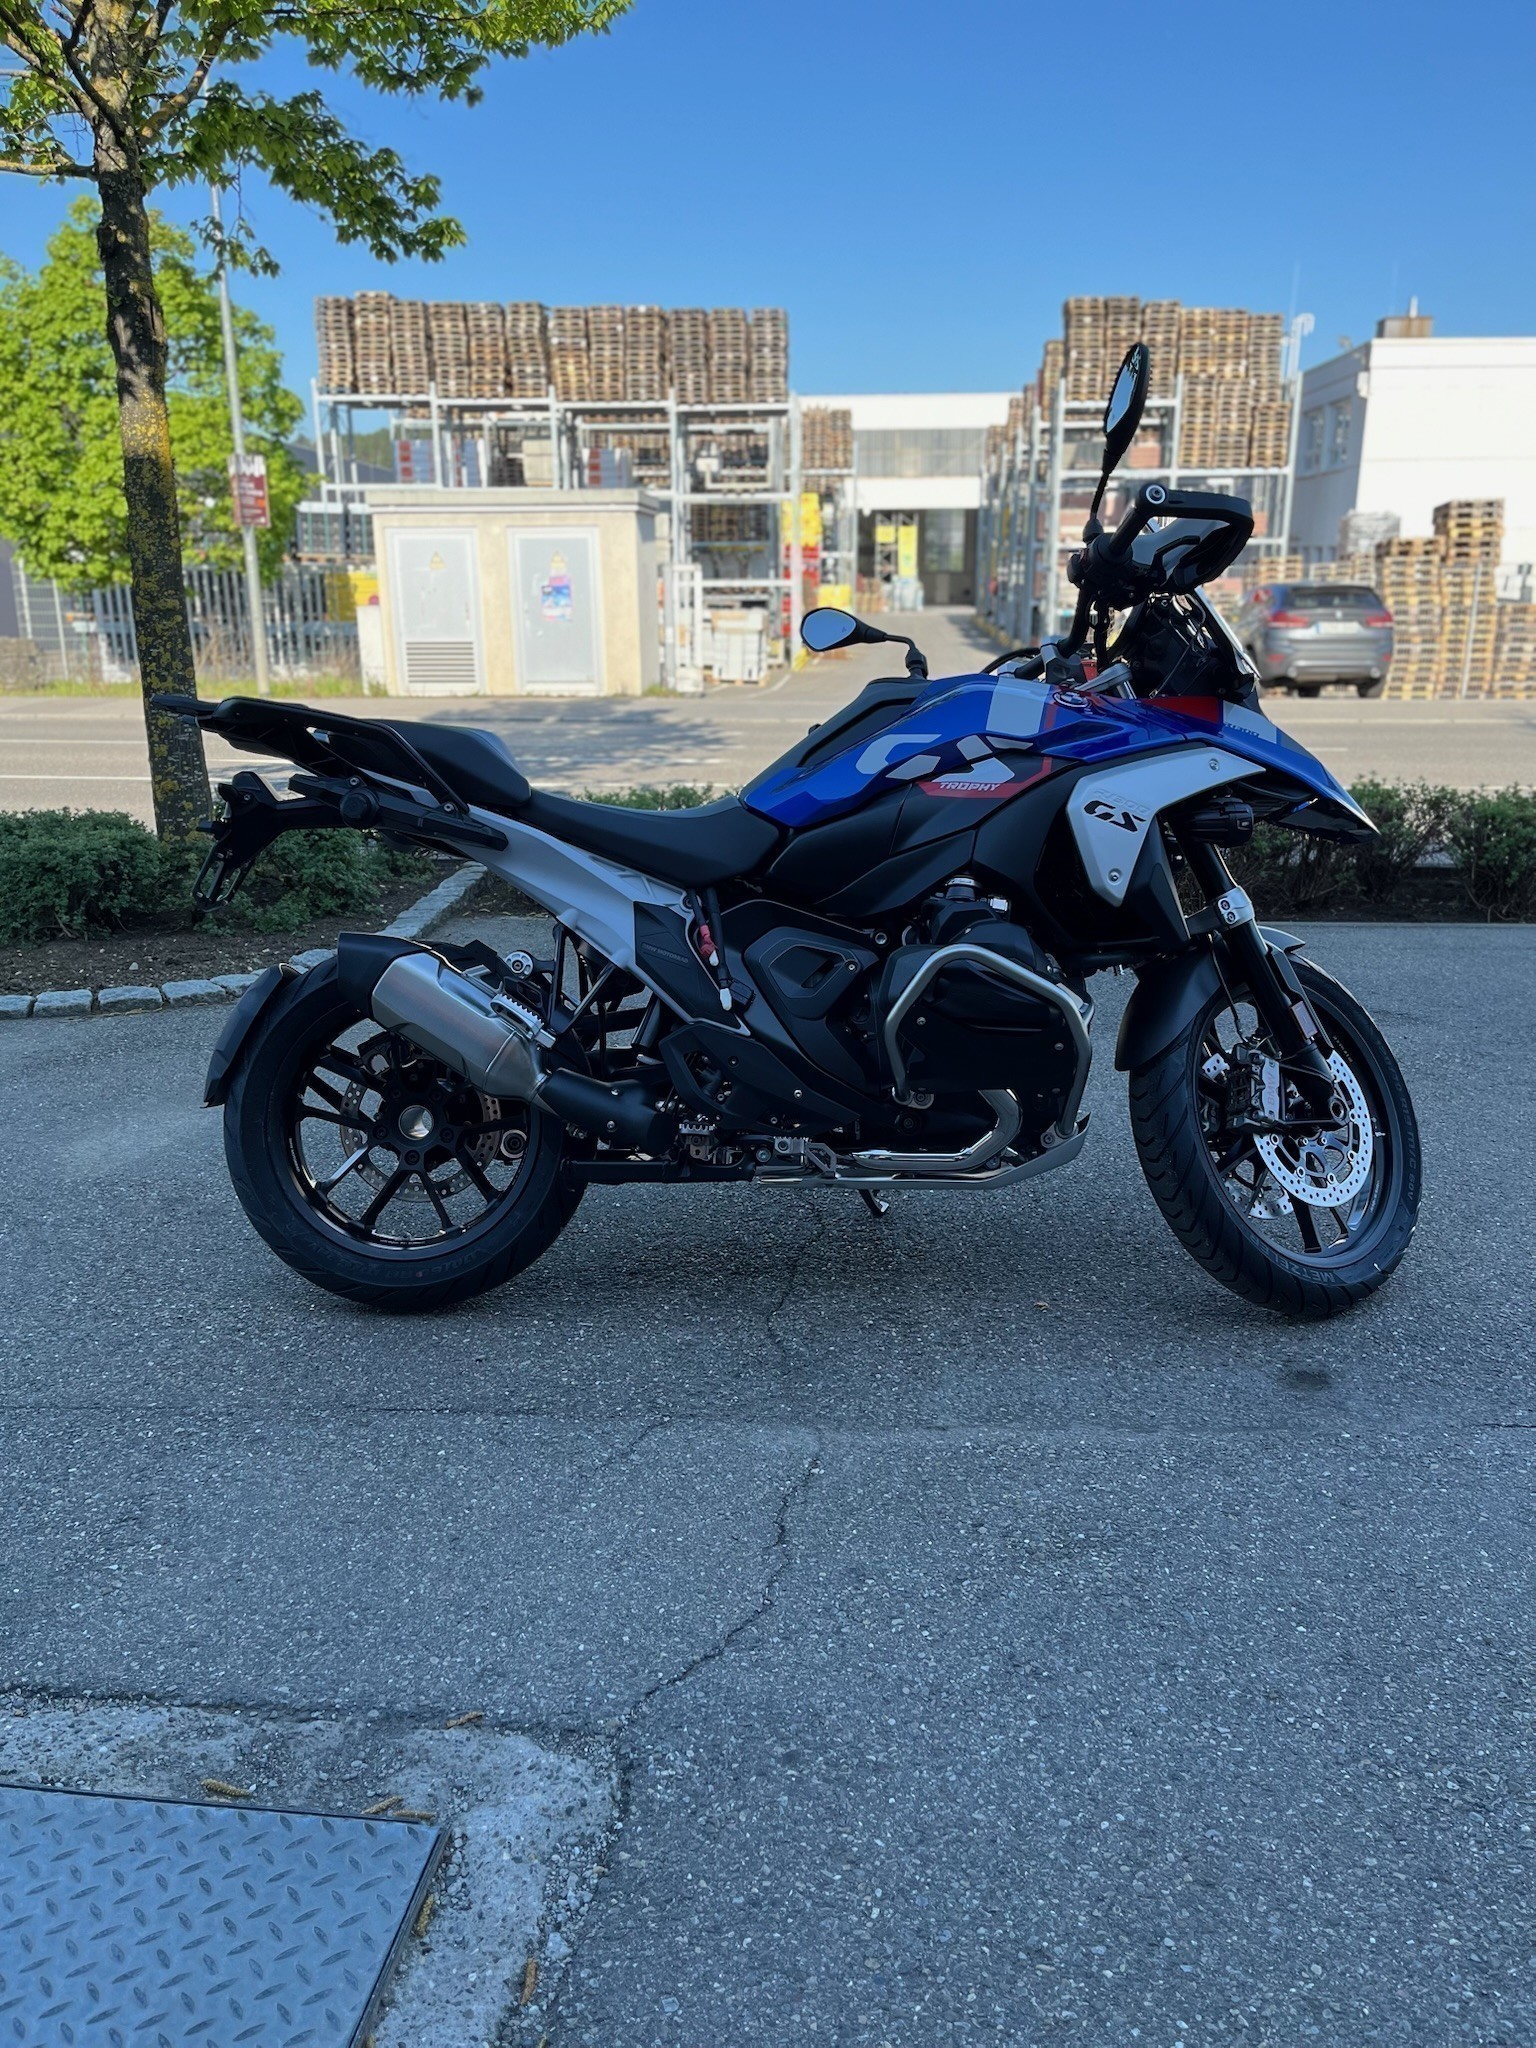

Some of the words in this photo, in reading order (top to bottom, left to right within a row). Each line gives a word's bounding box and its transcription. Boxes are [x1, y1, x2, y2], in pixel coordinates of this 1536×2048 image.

[856, 733, 1034, 783] GS
[940, 782, 1001, 792] TROPHY
[1083, 800, 1146, 832] GS
[1265, 1071, 1276, 1106] BMW
